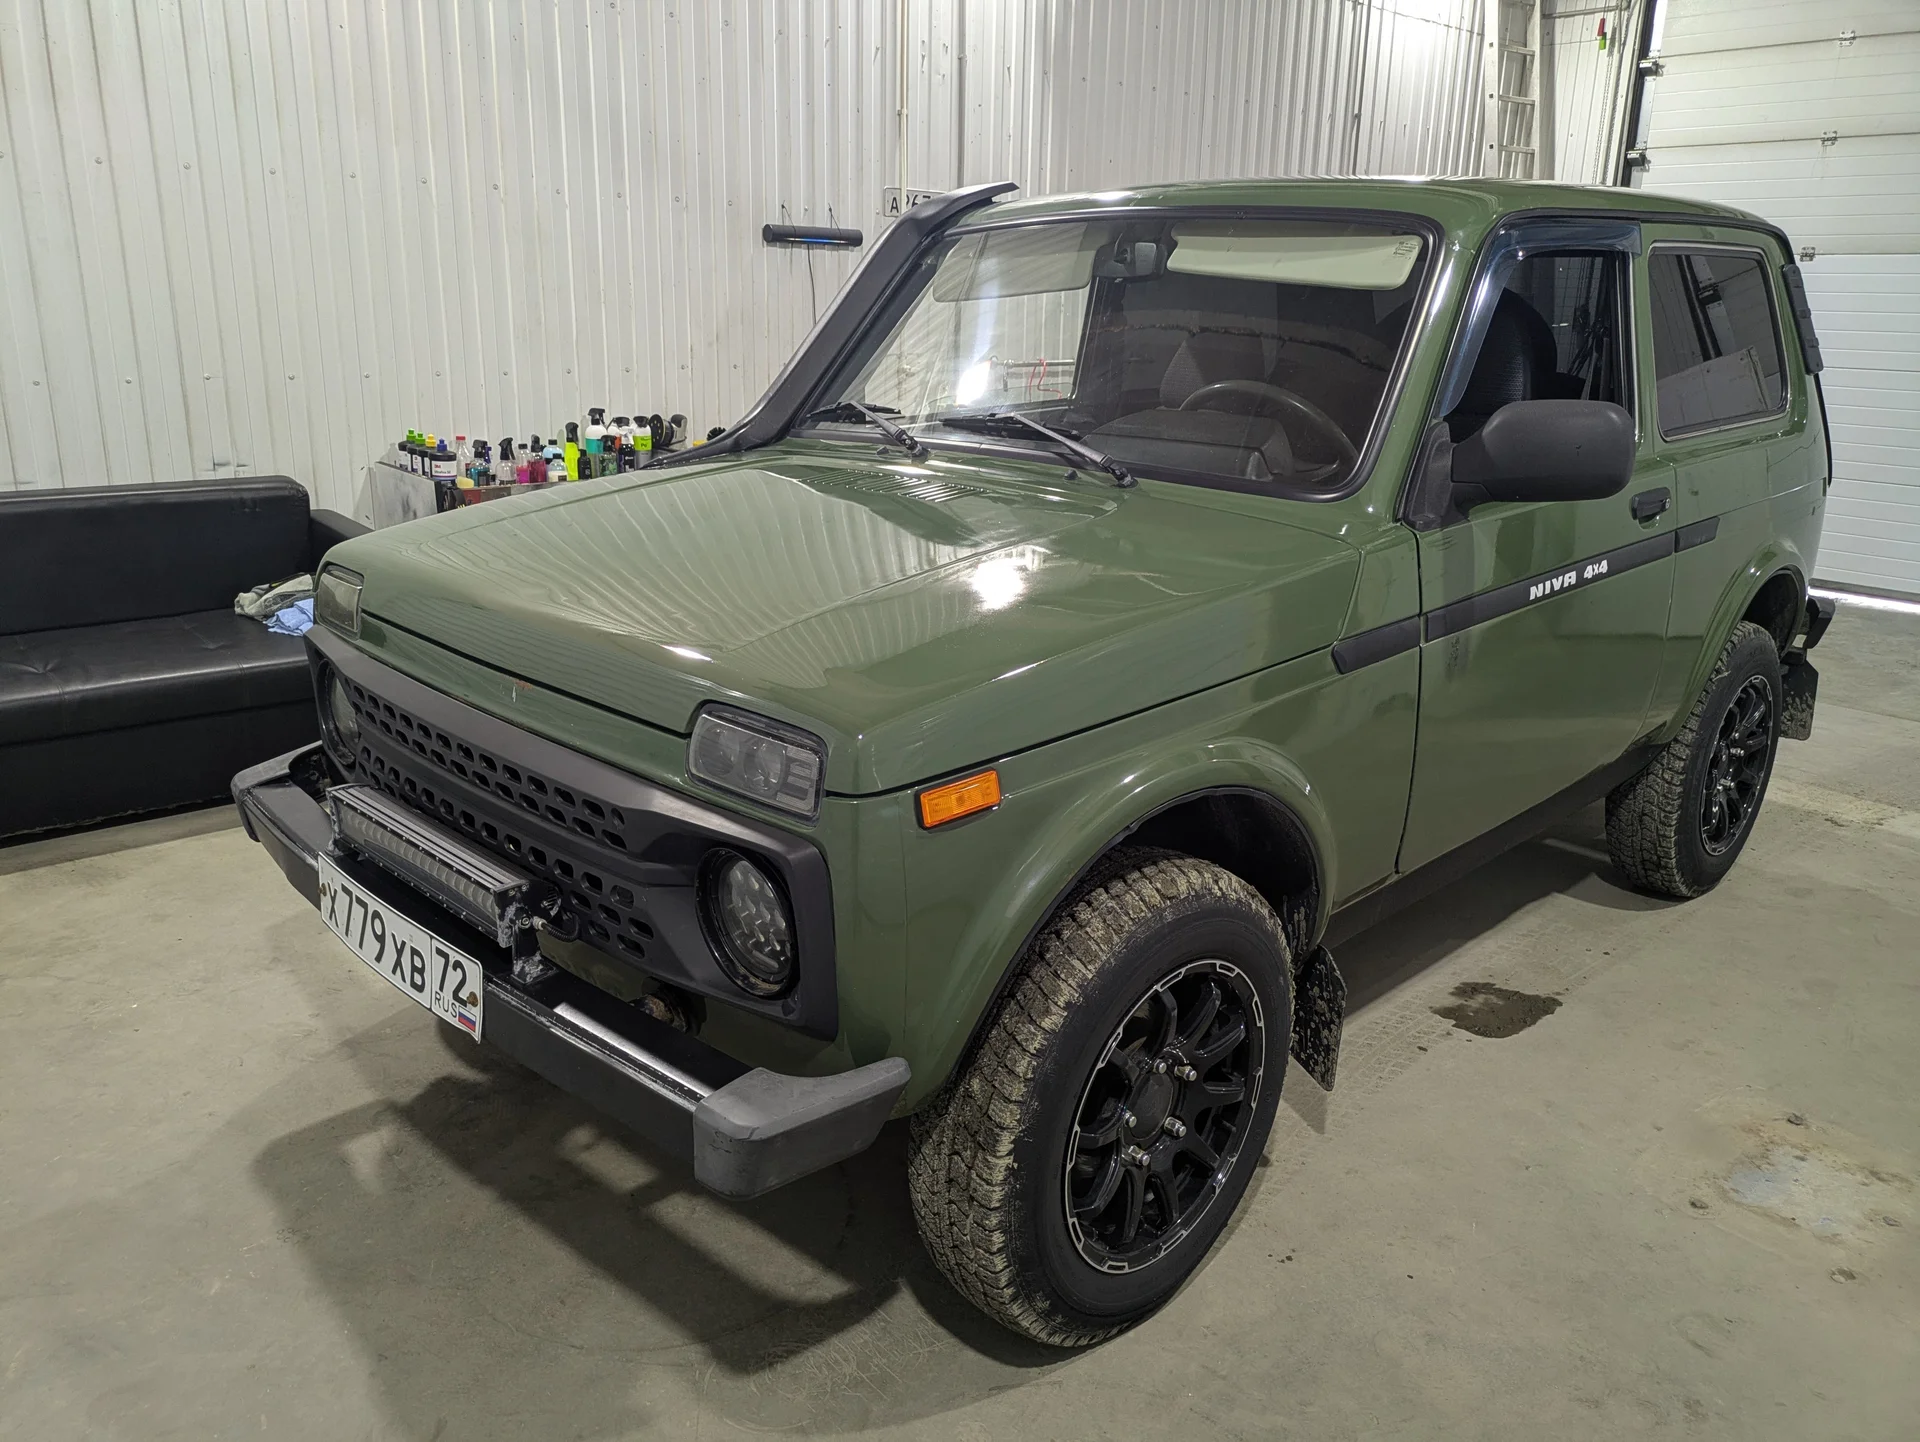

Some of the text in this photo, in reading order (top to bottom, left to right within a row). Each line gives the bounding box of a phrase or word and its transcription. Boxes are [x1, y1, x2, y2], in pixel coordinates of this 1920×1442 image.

[1529, 571, 1576, 600] NIVA
[435, 946, 468, 1007] 72
[434, 991, 457, 1018] RUS
